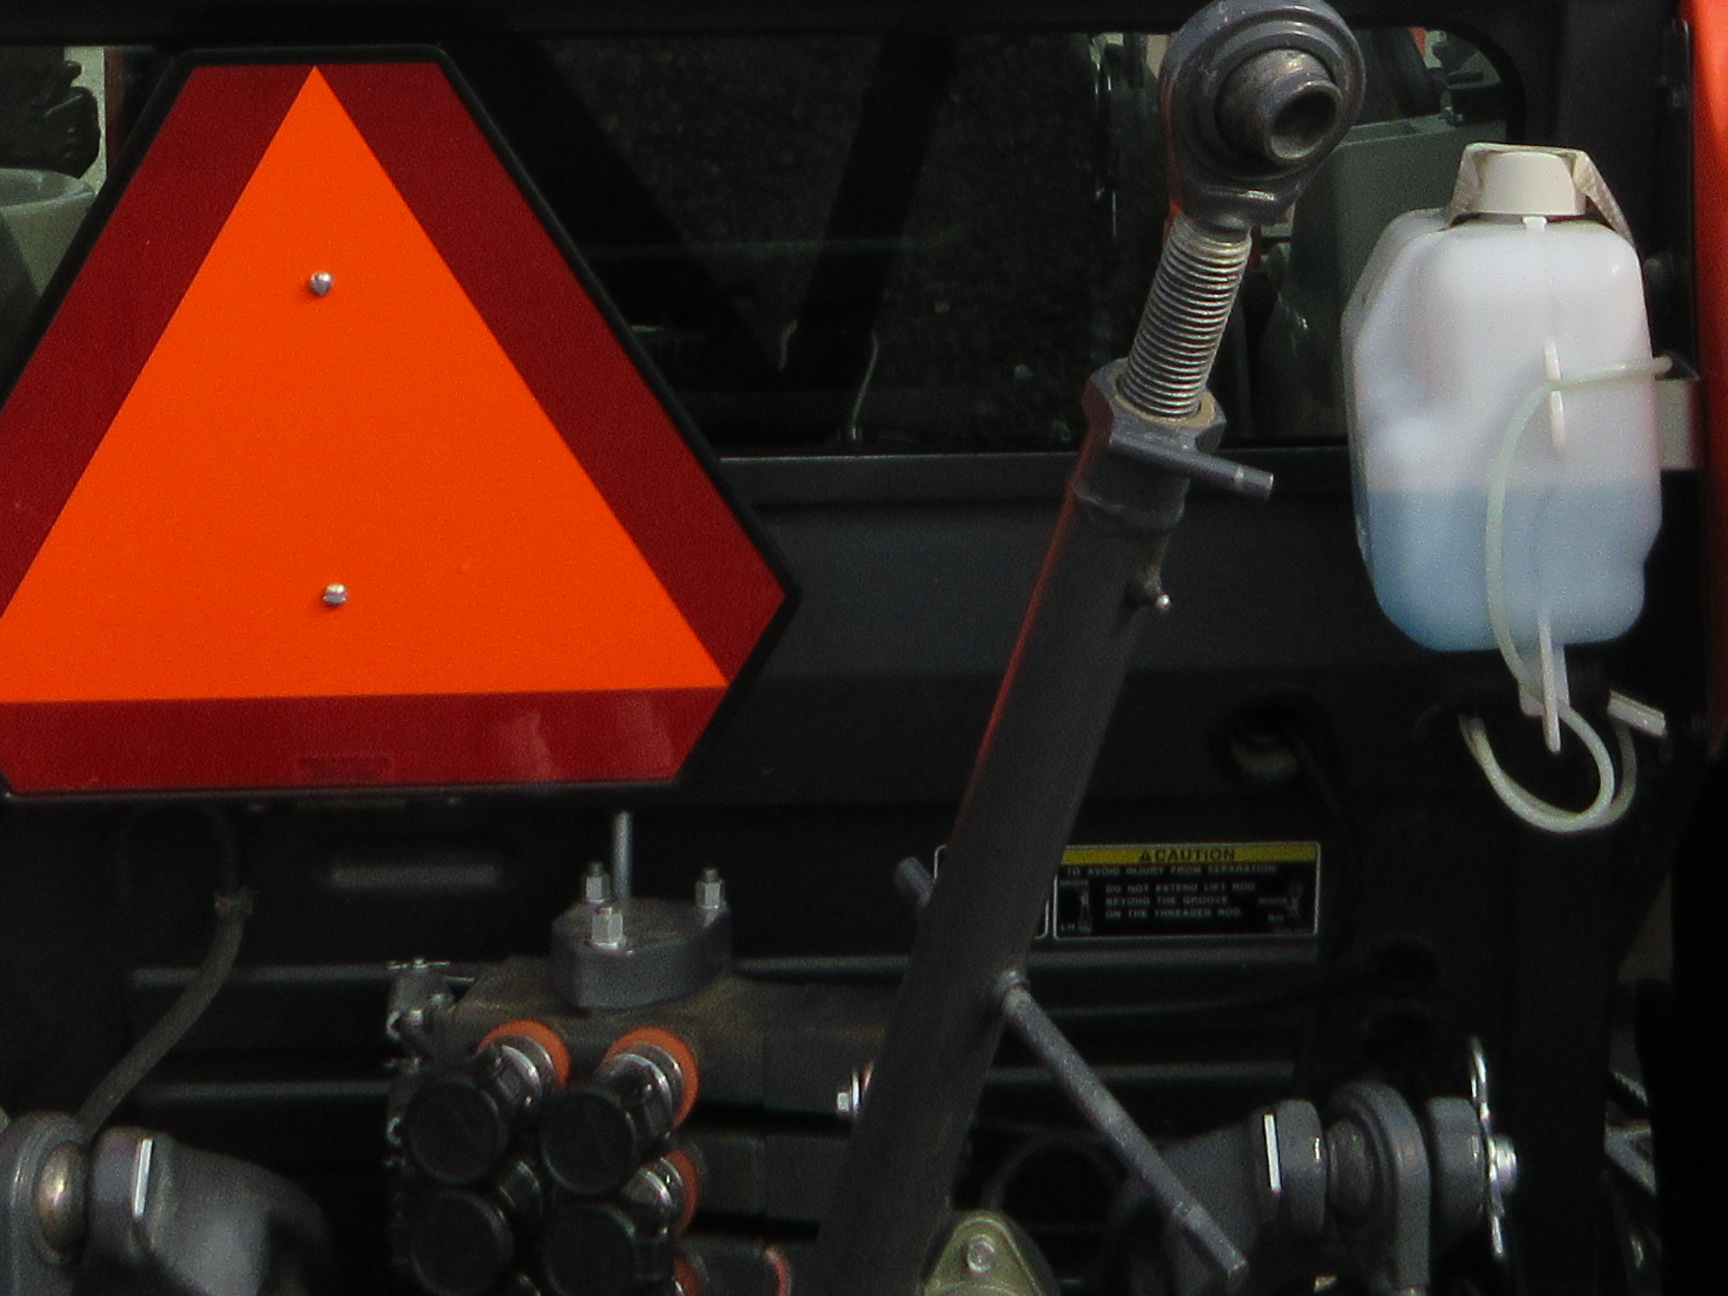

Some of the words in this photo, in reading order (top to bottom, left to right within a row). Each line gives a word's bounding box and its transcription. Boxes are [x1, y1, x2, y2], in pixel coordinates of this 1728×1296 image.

[1153, 848, 1235, 862] CAUTION
[1067, 867, 1081, 876] TO
[1087, 866, 1120, 876] AVOID
[1170, 865, 1202, 875] FROM
[1207, 864, 1276, 874] SEPARATION
[1105, 884, 1122, 894] DO
[1127, 883, 1149, 893] NOT
[1155, 883, 1198, 893] EXTEND
[1203, 882, 1226, 892] LIFT
[1105, 896, 1150, 906] BEYOND
[1157, 896, 1177, 905] THE
[1182, 895, 1229, 905] GROOVE
[1127, 909, 1148, 918] THE
